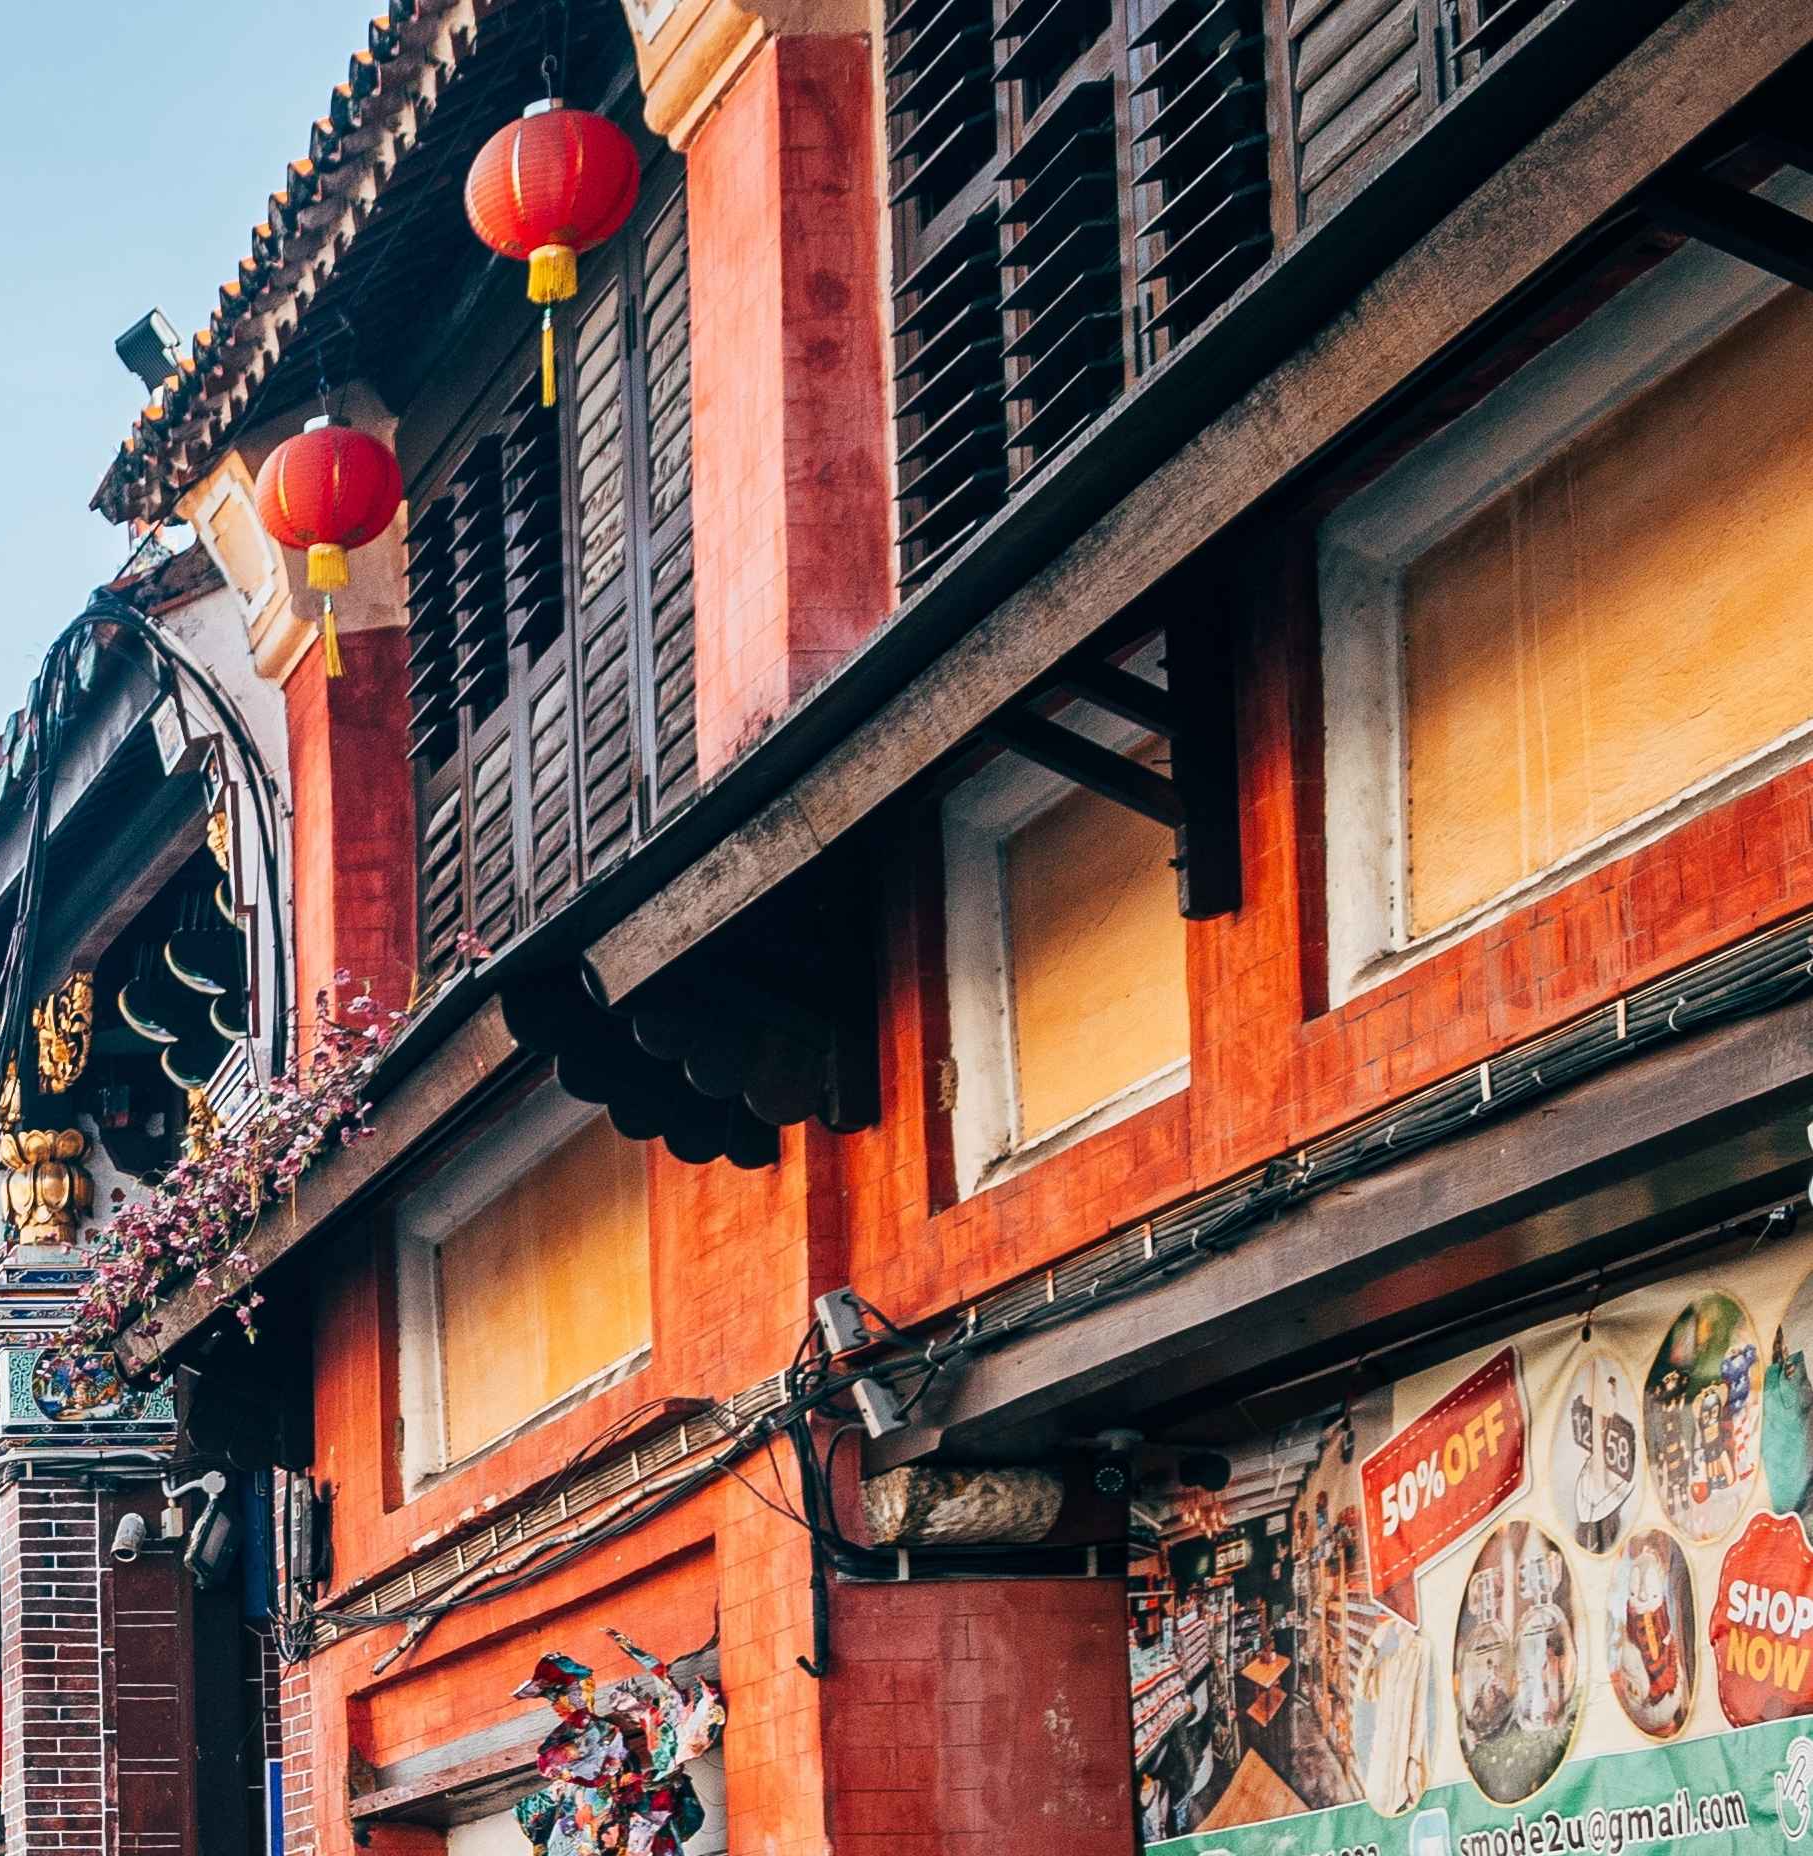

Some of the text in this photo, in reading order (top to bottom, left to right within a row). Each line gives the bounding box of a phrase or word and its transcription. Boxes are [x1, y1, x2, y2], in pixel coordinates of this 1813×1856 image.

[1382, 1400, 1506, 1537] 50% OFF
[1605, 1430, 1631, 1473] 58
[1726, 1580, 1812, 1639] SHOP
[1726, 1629, 1811, 1693] NOW
